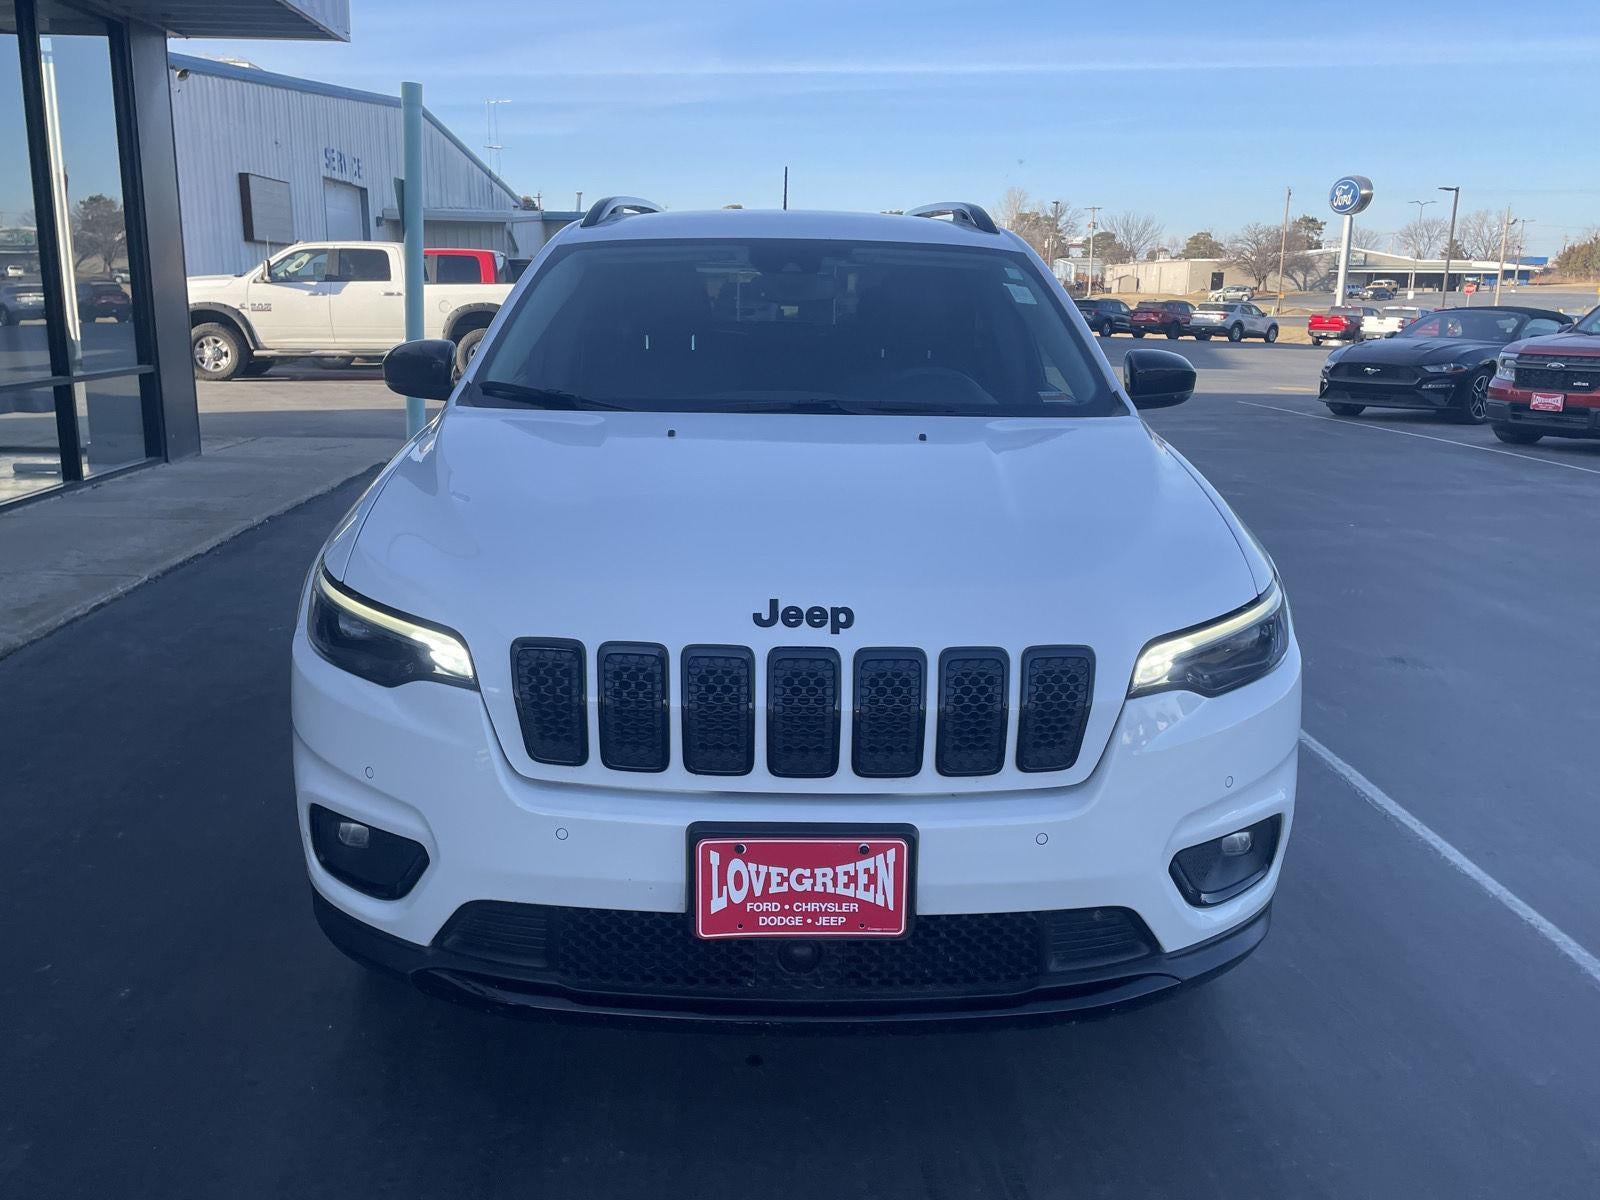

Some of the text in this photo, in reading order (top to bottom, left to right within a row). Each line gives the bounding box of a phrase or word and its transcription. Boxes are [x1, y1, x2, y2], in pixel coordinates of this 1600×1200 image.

[324, 147, 361, 179] SERVCE
[1333, 184, 1354, 207] Ford
[752, 598, 855, 635] Jeep
[709, 847, 896, 915] LOVEGREEN
[746, 902, 859, 913] FORD CHRYSLER
[758, 916, 847, 926] DODGE JEEP
